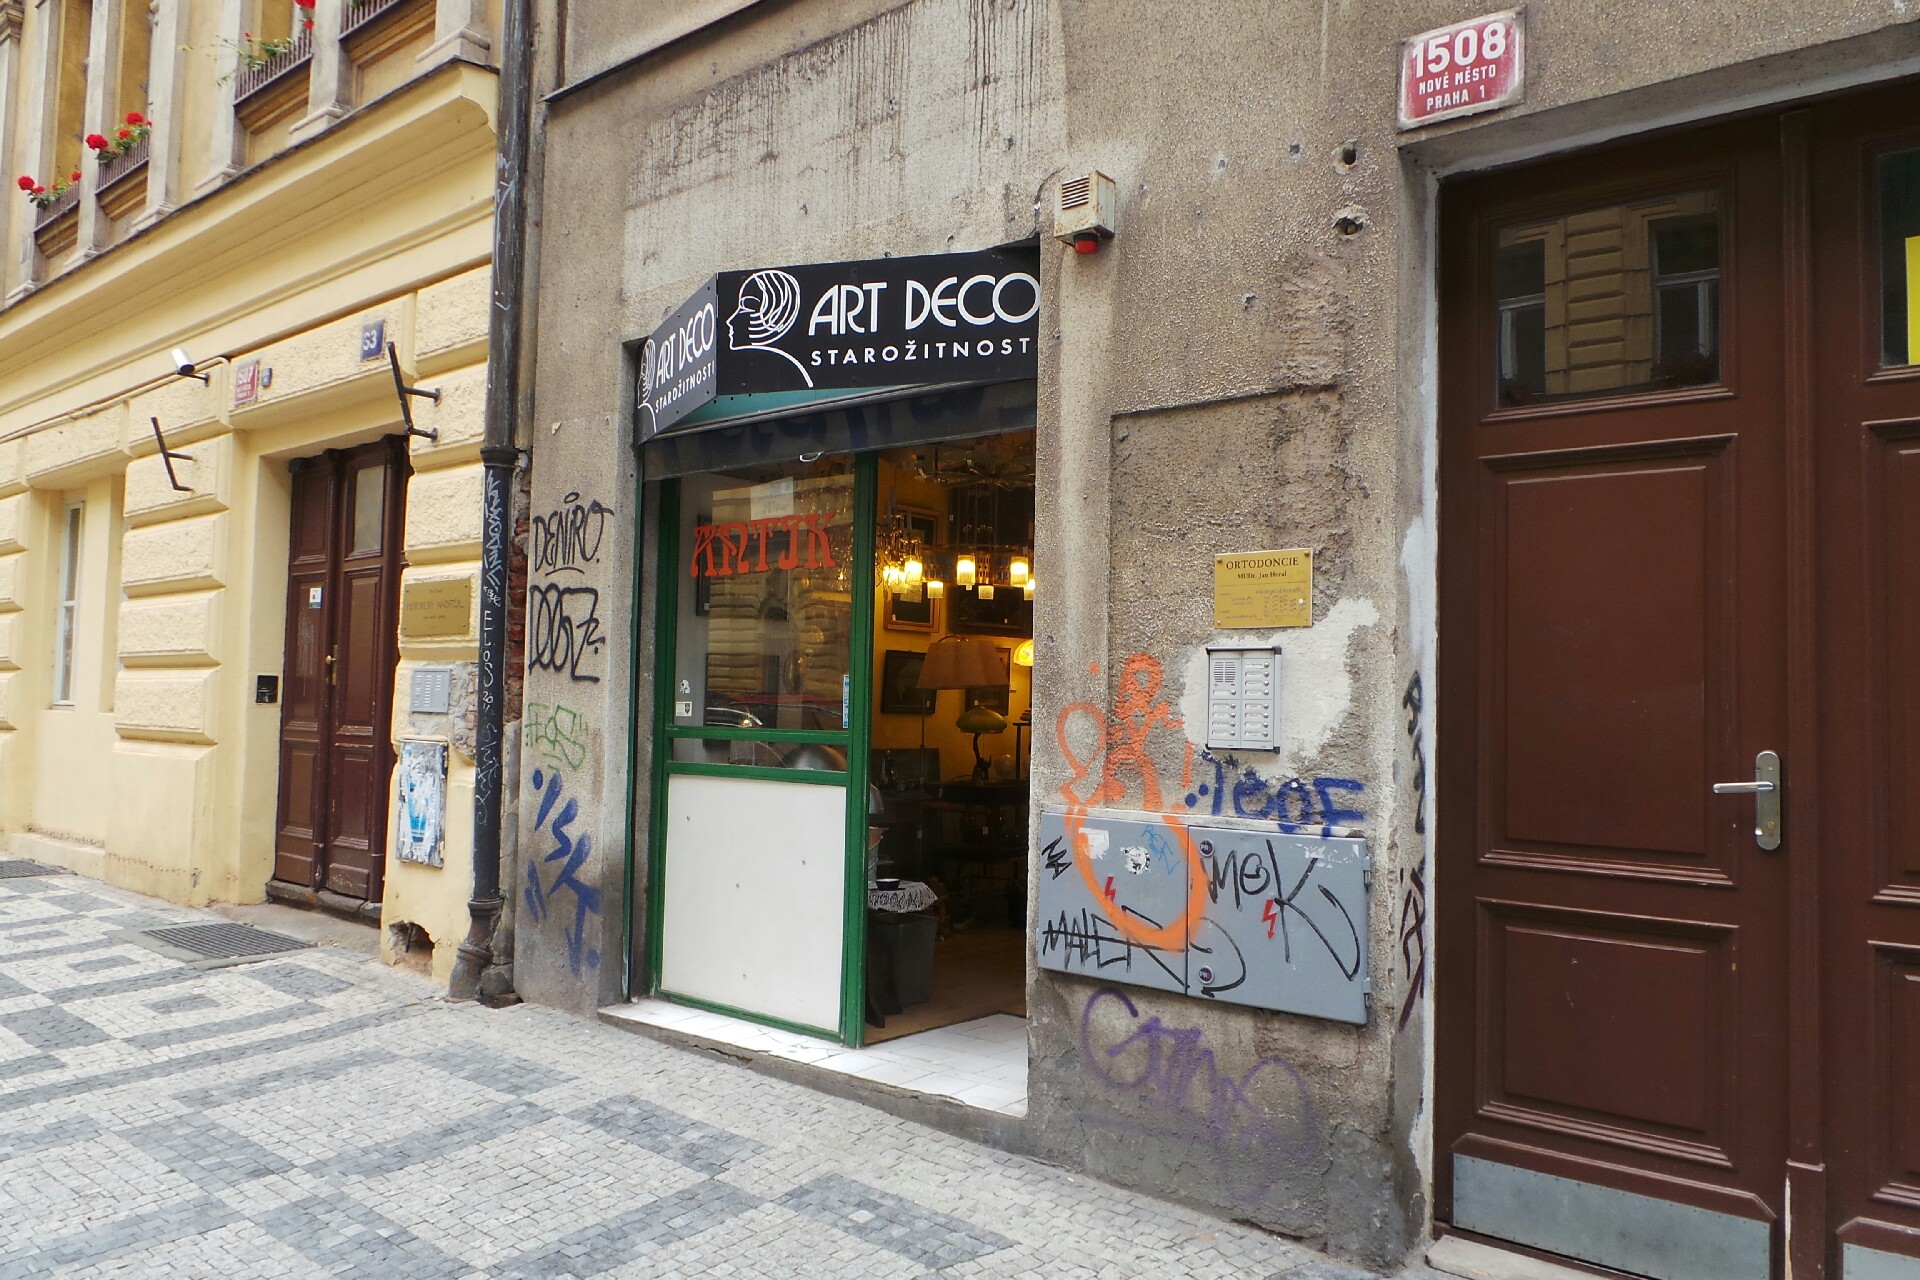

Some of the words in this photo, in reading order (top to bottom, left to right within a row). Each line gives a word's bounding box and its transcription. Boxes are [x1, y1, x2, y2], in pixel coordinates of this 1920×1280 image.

[1412, 22, 1506, 78] 1508
[1419, 71, 1449, 95] NOVÉ
[1454, 64, 1496, 86] MĚSTO
[1426, 89, 1469, 111] PRAHA
[1479, 84, 1485, 99] 1
[808, 282, 888, 336] ART
[905, 272, 1040, 330] DECO
[656, 333, 676, 388] ART
[679, 303, 715, 371] DECO
[655, 360, 715, 413] STAROŽITNOSTI
[1226, 556, 1299, 570] ORTODONCIE
